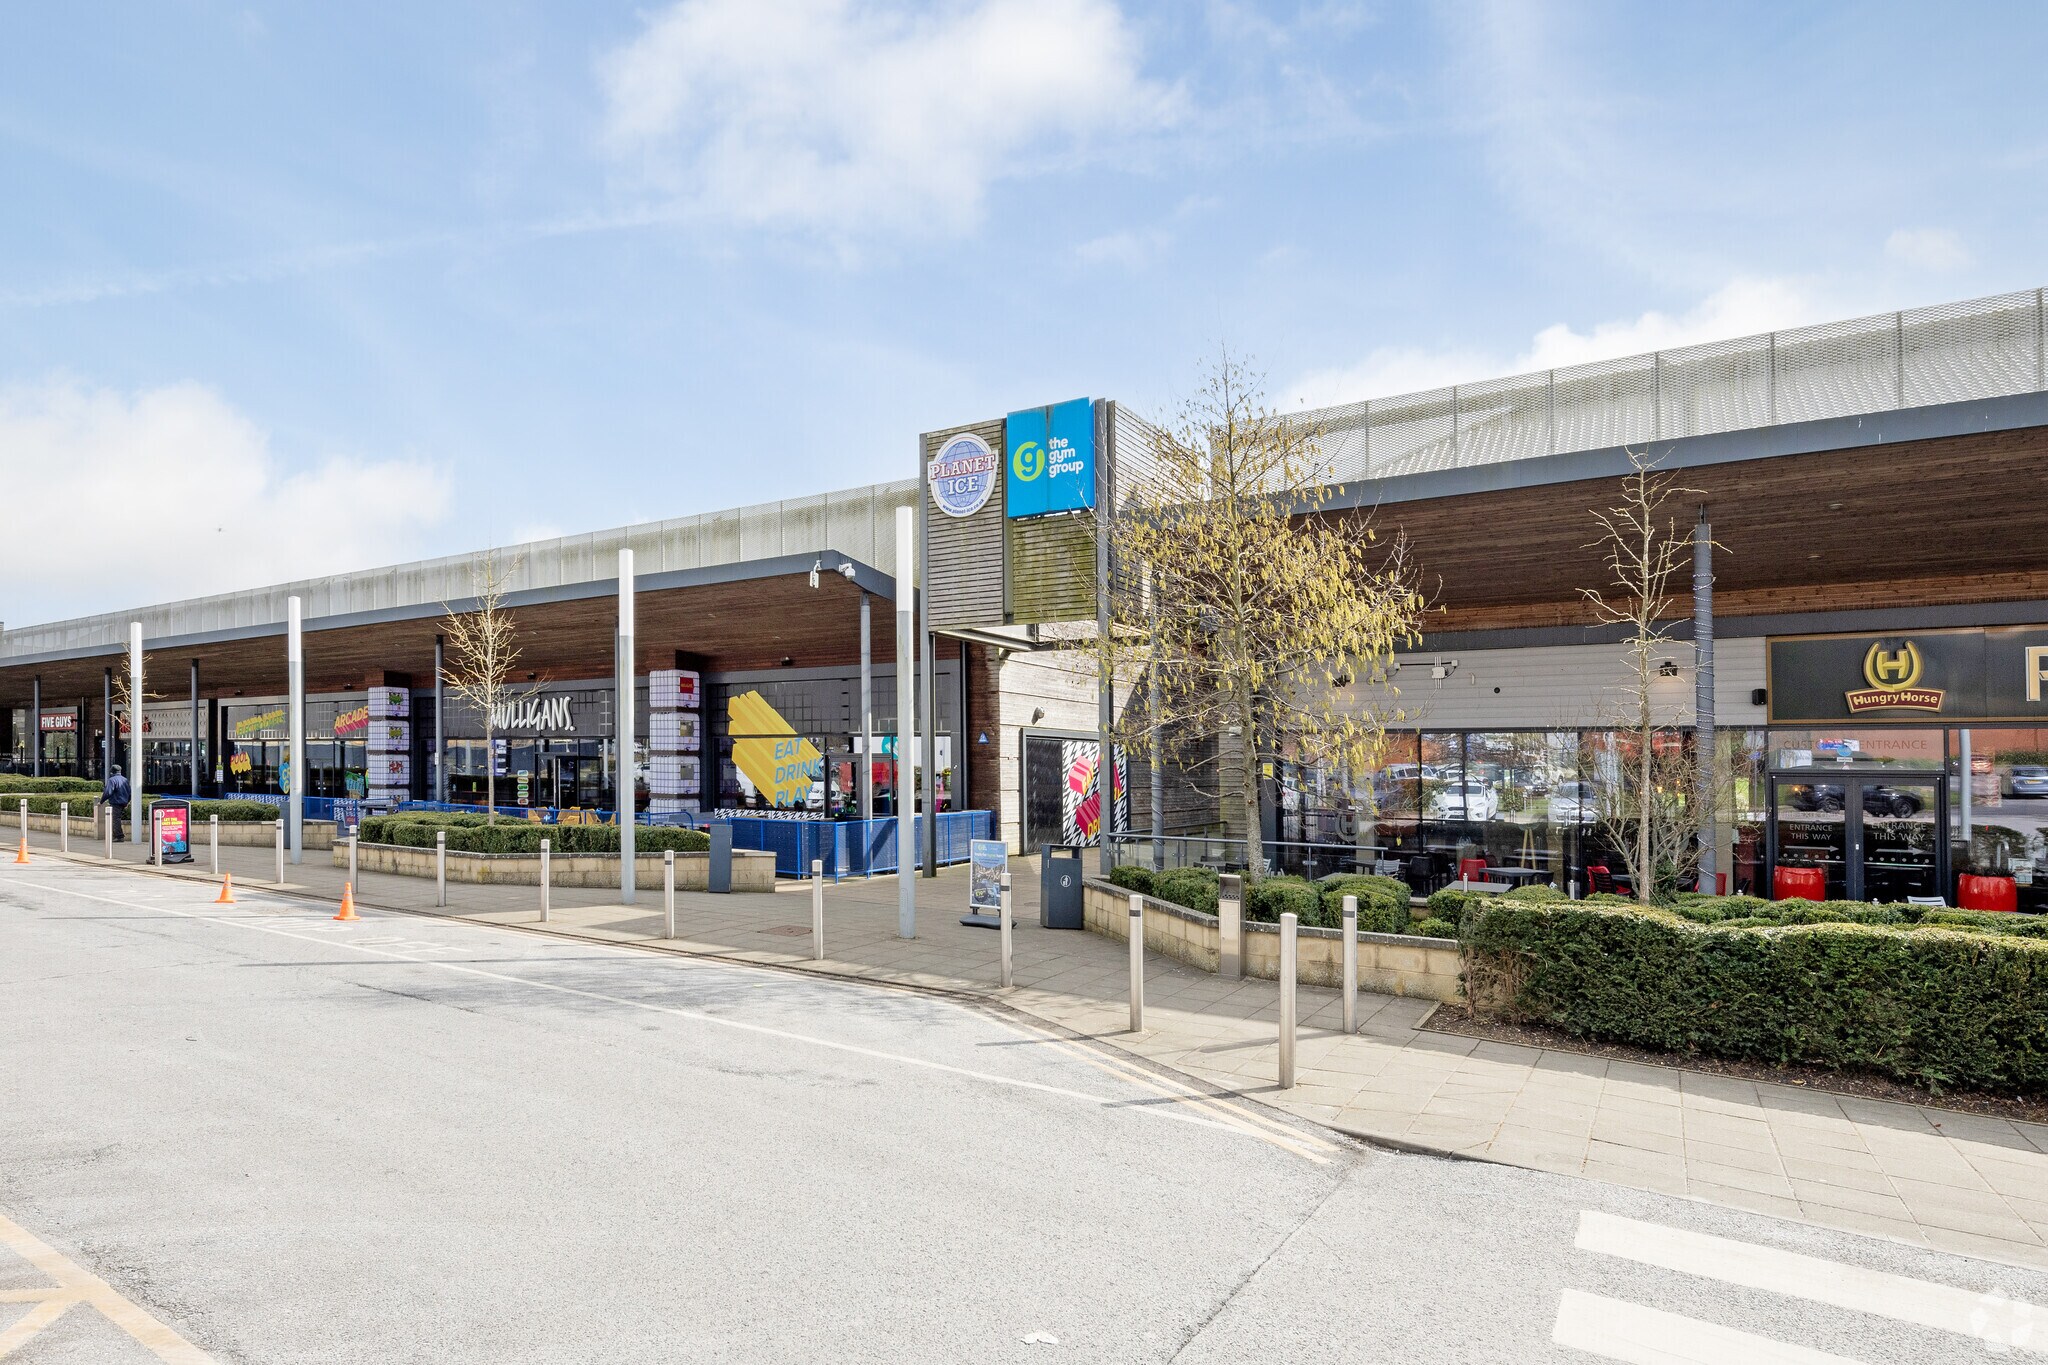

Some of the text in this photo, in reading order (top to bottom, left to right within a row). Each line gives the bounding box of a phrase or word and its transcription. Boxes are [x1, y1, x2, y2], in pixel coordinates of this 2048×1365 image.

[1048, 437, 1068, 448] the
[1048, 448, 1076, 463] gym
[930, 454, 995, 480] PLANET
[1048, 461, 1084, 479] group
[947, 475, 978, 496] ICE
[41, 716, 72, 728] FIVE GUYS
[774, 737, 803, 760] EAT
[1859, 740, 1928, 750] ENTRANCE
[230, 752, 249, 765] POOL
[775, 756, 822, 784] DRINK
[775, 784, 814, 808] PLAY
[1789, 824, 1833, 832] ENTRANCE
[1871, 821, 1927, 831] ENTRANCE
[1791, 832, 1832, 841] THIS WAY
[1873, 832, 1926, 842] THIS WAY
